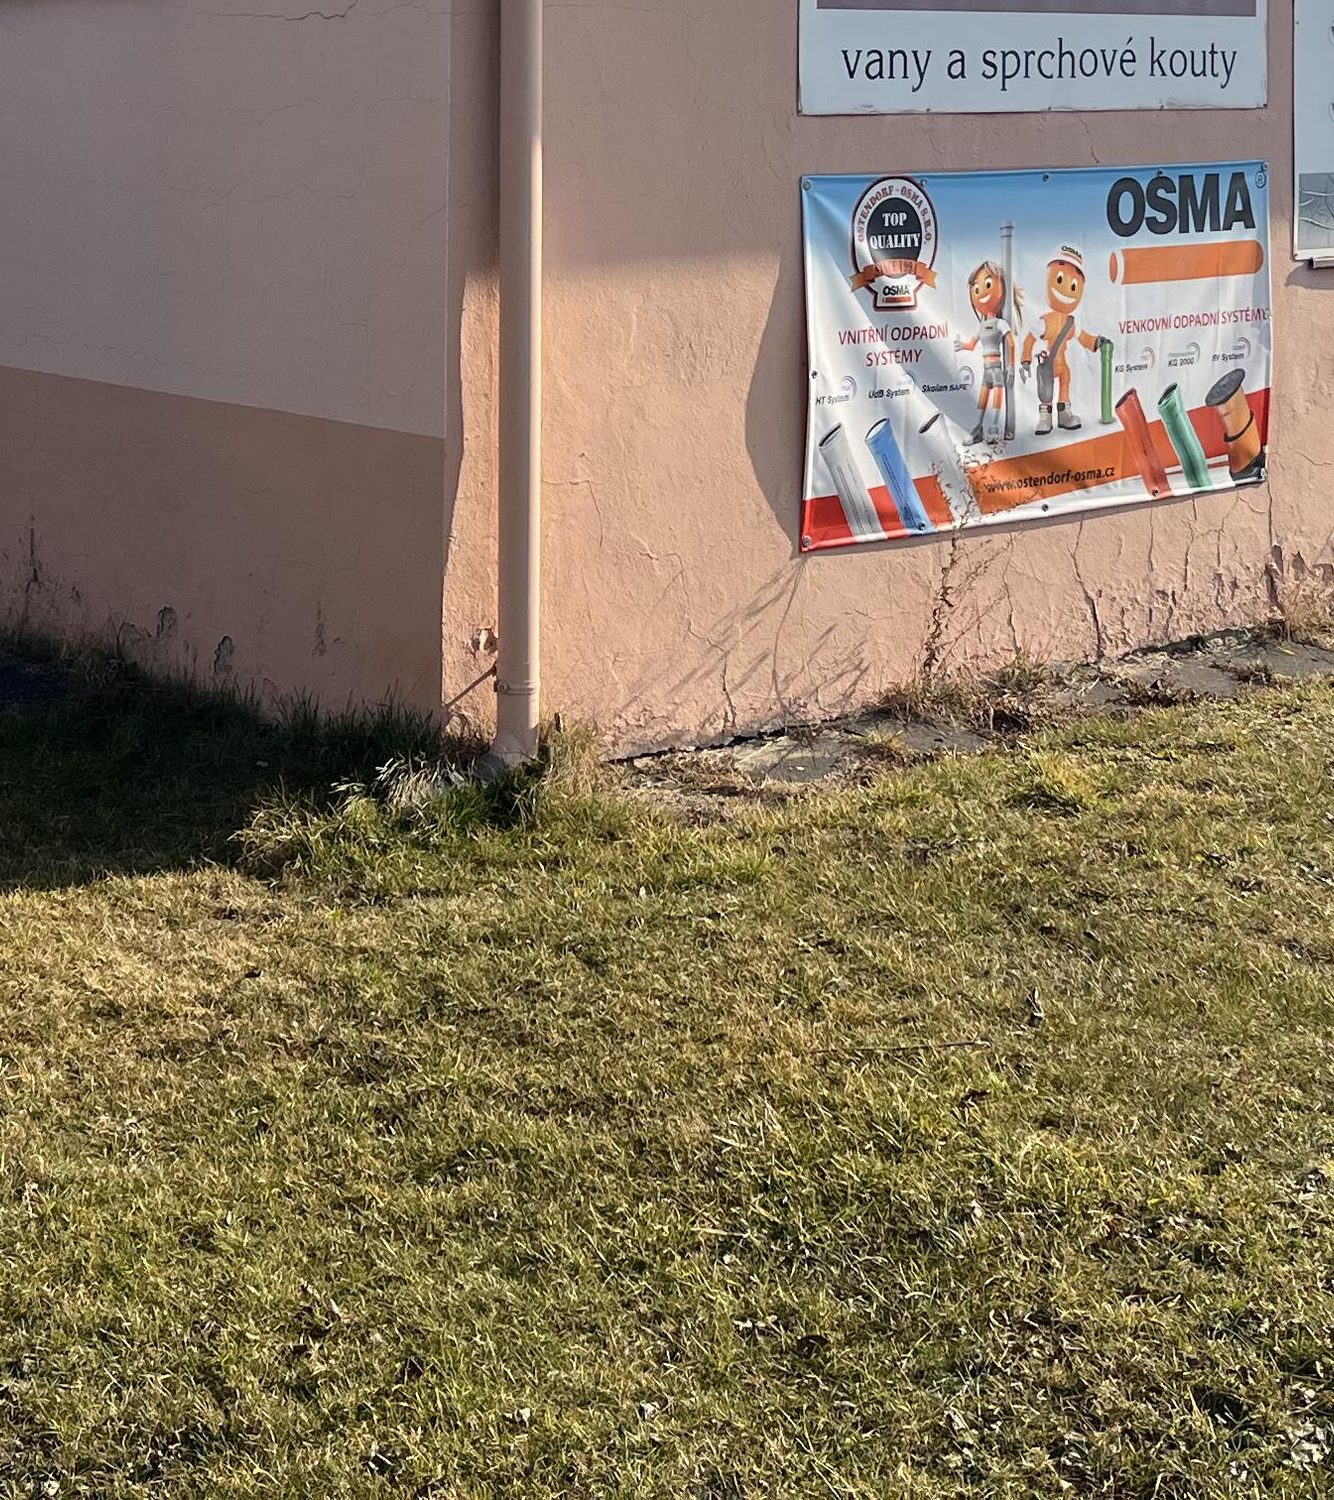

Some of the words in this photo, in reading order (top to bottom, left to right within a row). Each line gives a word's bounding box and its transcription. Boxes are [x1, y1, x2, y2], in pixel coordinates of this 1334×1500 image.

[841, 48, 931, 93] vany
[947, 48, 967, 80] a
[981, 37, 1137, 92] sprchové
[1149, 36, 1238, 89] kouty
[857, 185, 894, 243] OSTENDORF
[900, 186, 924, 209] OSMA
[1107, 172, 1257, 237] OSMA
[882, 212, 907, 227] TOP
[869, 232, 921, 249] QUALITY
[882, 285, 910, 296] OSMA
[1119, 314, 1173, 335] VENKOVNÍ
[1174, 309, 1221, 329] ODPADNÍ
[1221, 306, 1267, 325] SYSTÉMY
[838, 324, 889, 346] VNITŘNÍ
[891, 322, 949, 342] ODPADNÍ
[866, 348, 923, 367] SYSTÉMY
[985, 466, 1115, 493] www.ostendorf-osma.cz
